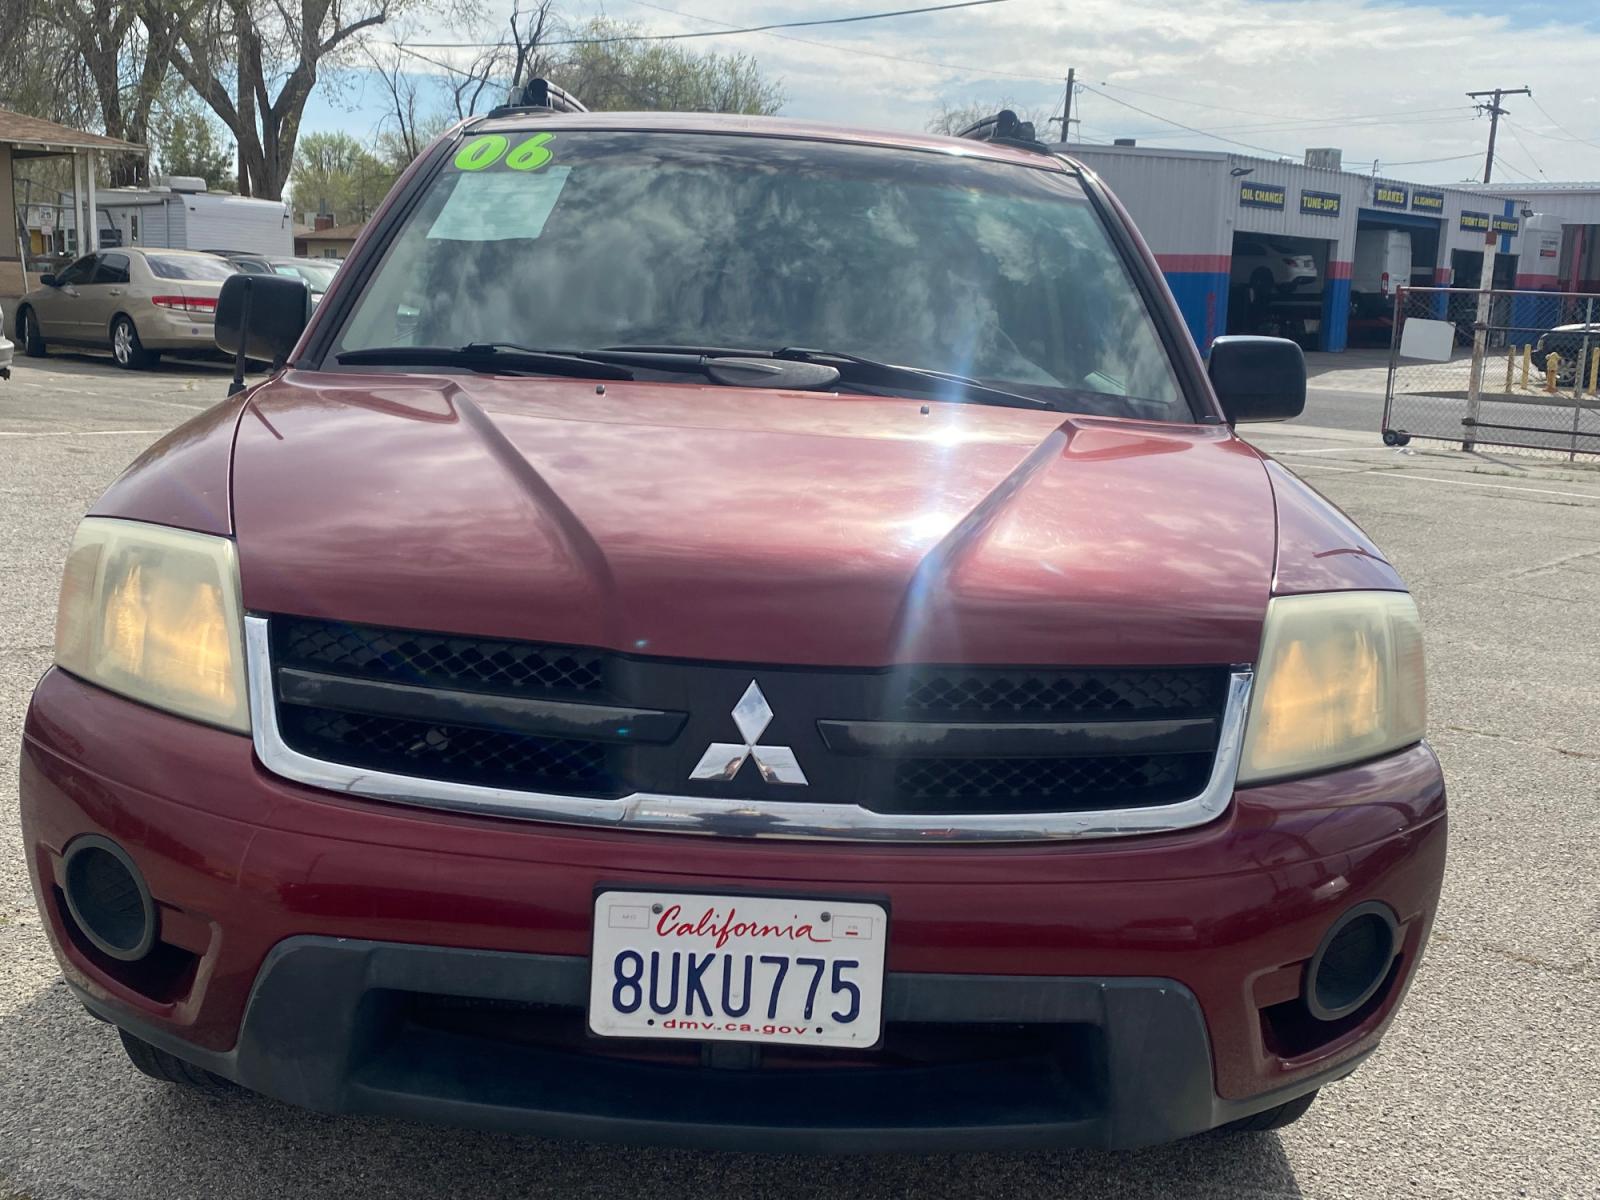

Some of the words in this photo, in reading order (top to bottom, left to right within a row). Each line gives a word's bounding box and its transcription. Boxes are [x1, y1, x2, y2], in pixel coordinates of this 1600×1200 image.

[455, 133, 556, 170] 06
[1242, 189, 1253, 200] OIL
[1255, 191, 1283, 203] CHANGE
[1303, 196, 1338, 210] TUNE-UPS
[1378, 189, 1404, 204] BRAKES
[1414, 196, 1443, 208] ALIGNMENT
[656, 905, 832, 948] California
[612, 950, 860, 1023] 8UKU775
[663, 1019, 808, 1035] dmv.ca.gov
